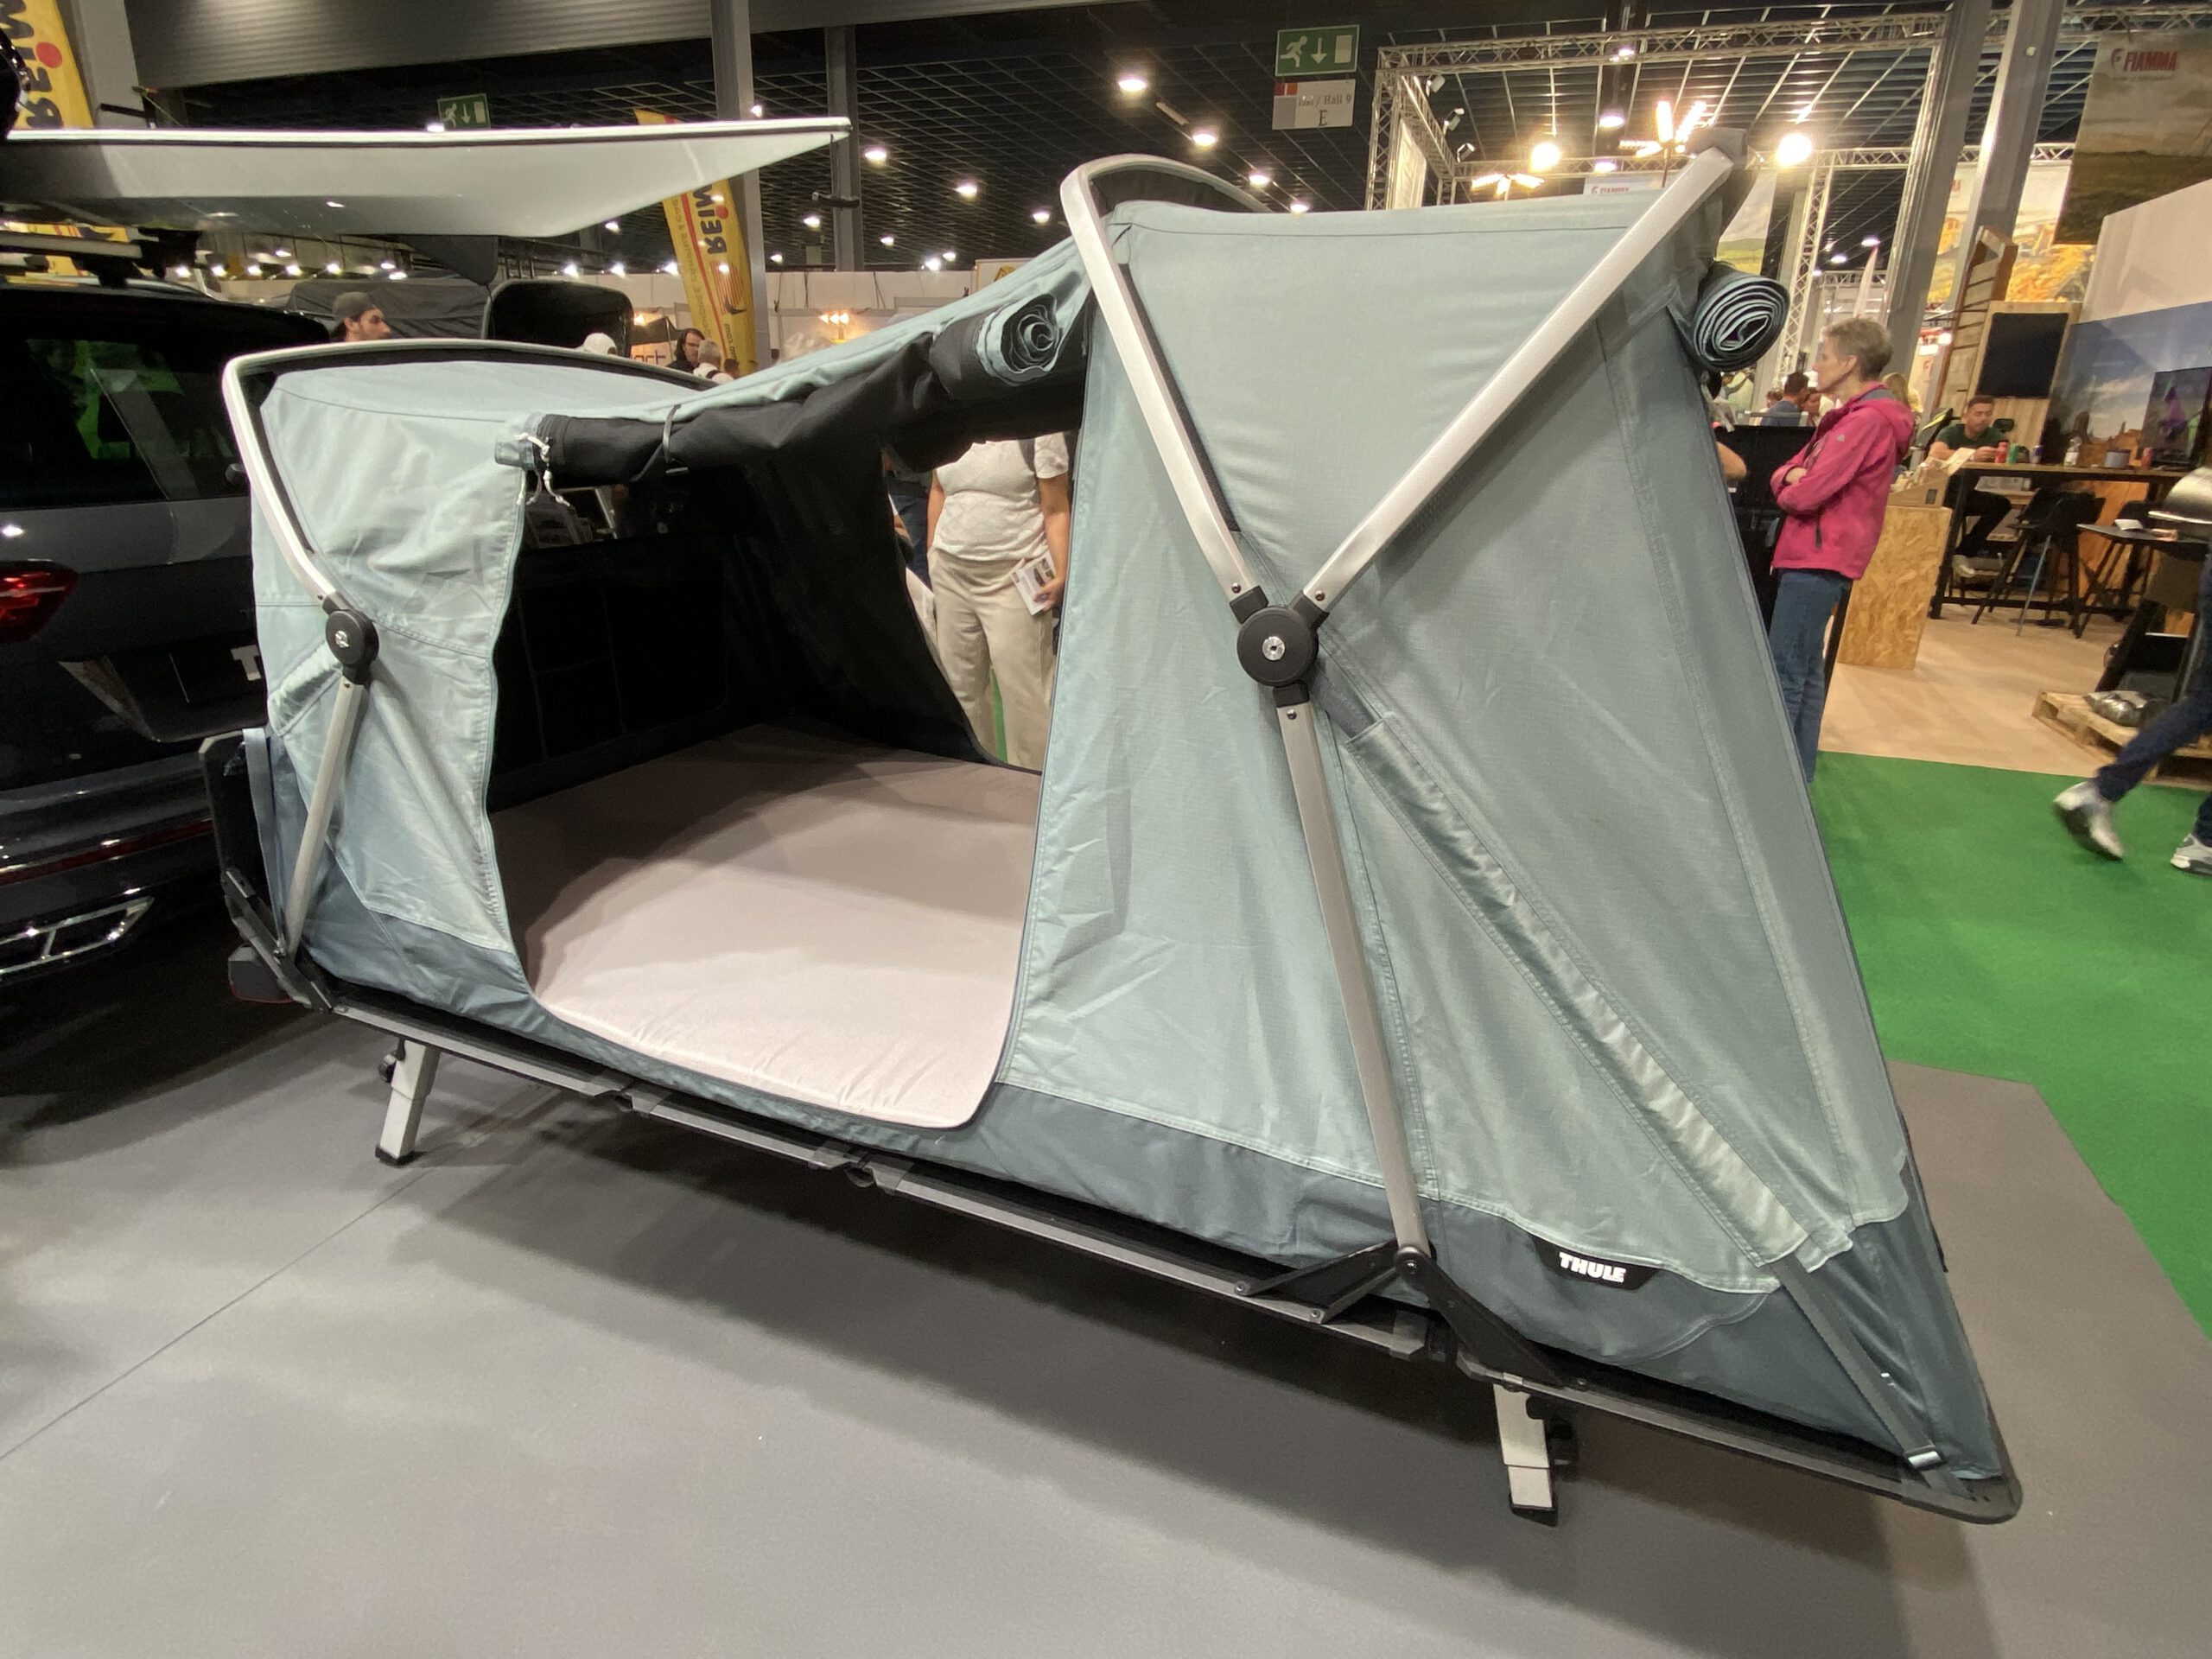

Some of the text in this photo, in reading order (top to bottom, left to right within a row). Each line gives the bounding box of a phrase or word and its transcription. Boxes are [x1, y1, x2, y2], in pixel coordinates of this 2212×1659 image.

[1324, 93, 1343, 105] Hall
[1319, 109, 1328, 126] E
[1559, 1251, 1627, 1283] THULE
